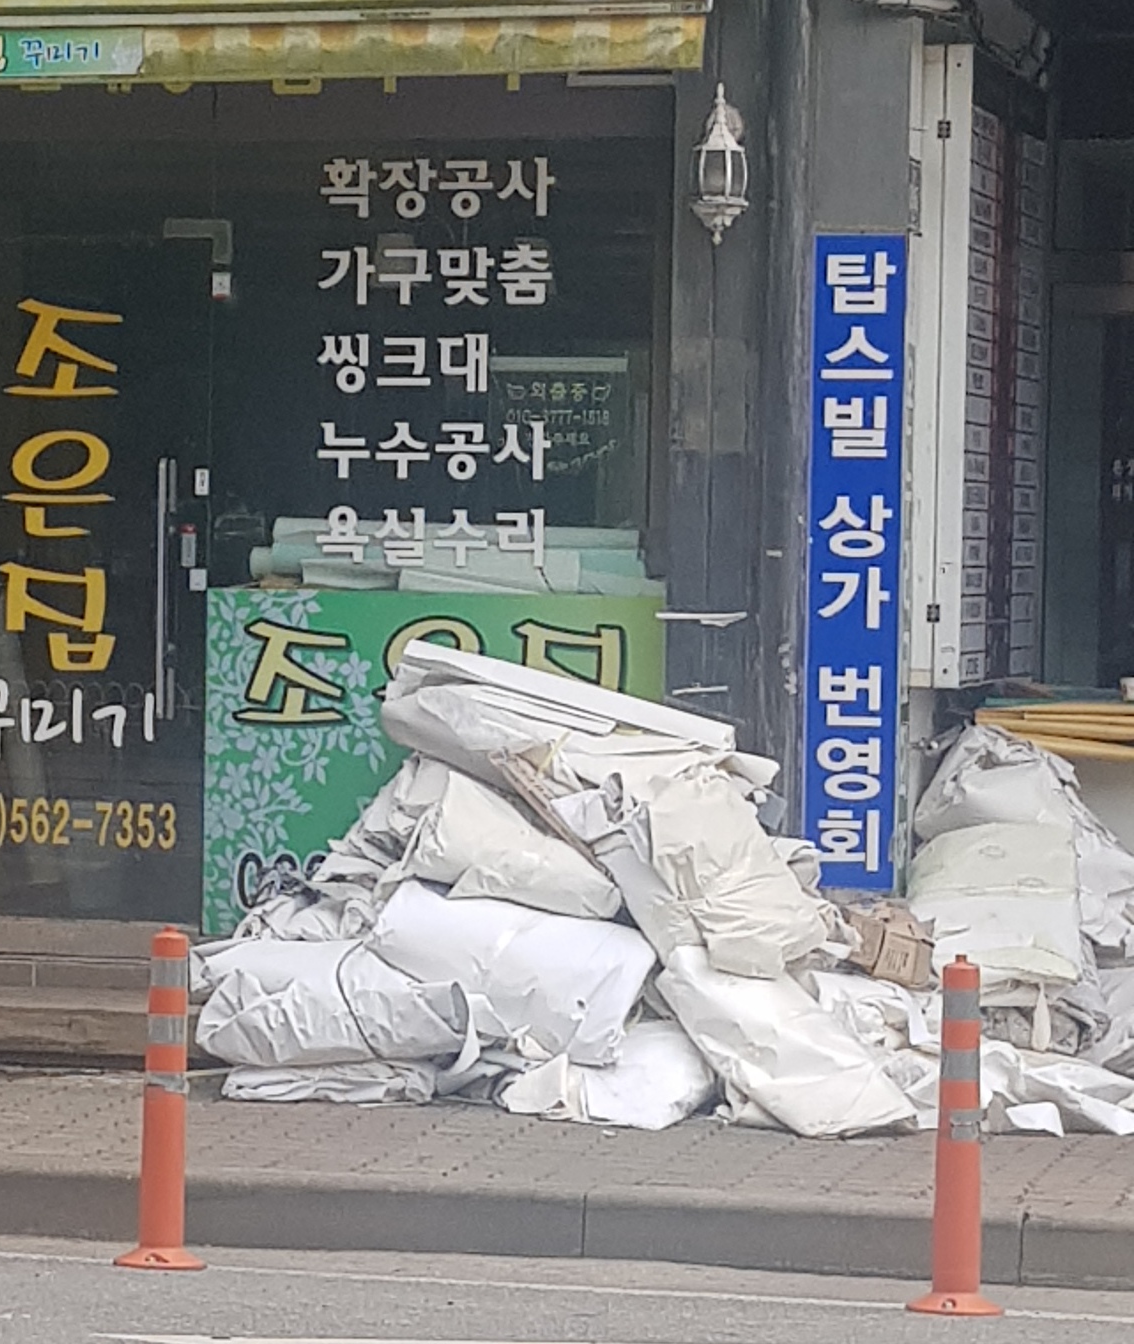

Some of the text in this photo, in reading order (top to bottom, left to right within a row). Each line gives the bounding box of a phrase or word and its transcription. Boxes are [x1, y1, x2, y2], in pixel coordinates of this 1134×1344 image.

[18, 36, 101, 70] 꾸미기
[319, 156, 556, 219] 확장공사
[317, 244, 554, 306] 가구맞춤
[317, 333, 490, 394] 씽크대
[316, 421, 551, 481] 누수공사
[316, 504, 547, 568] 욕실수리
[816, 251, 896, 873] 탑스빌 상가 번영회
